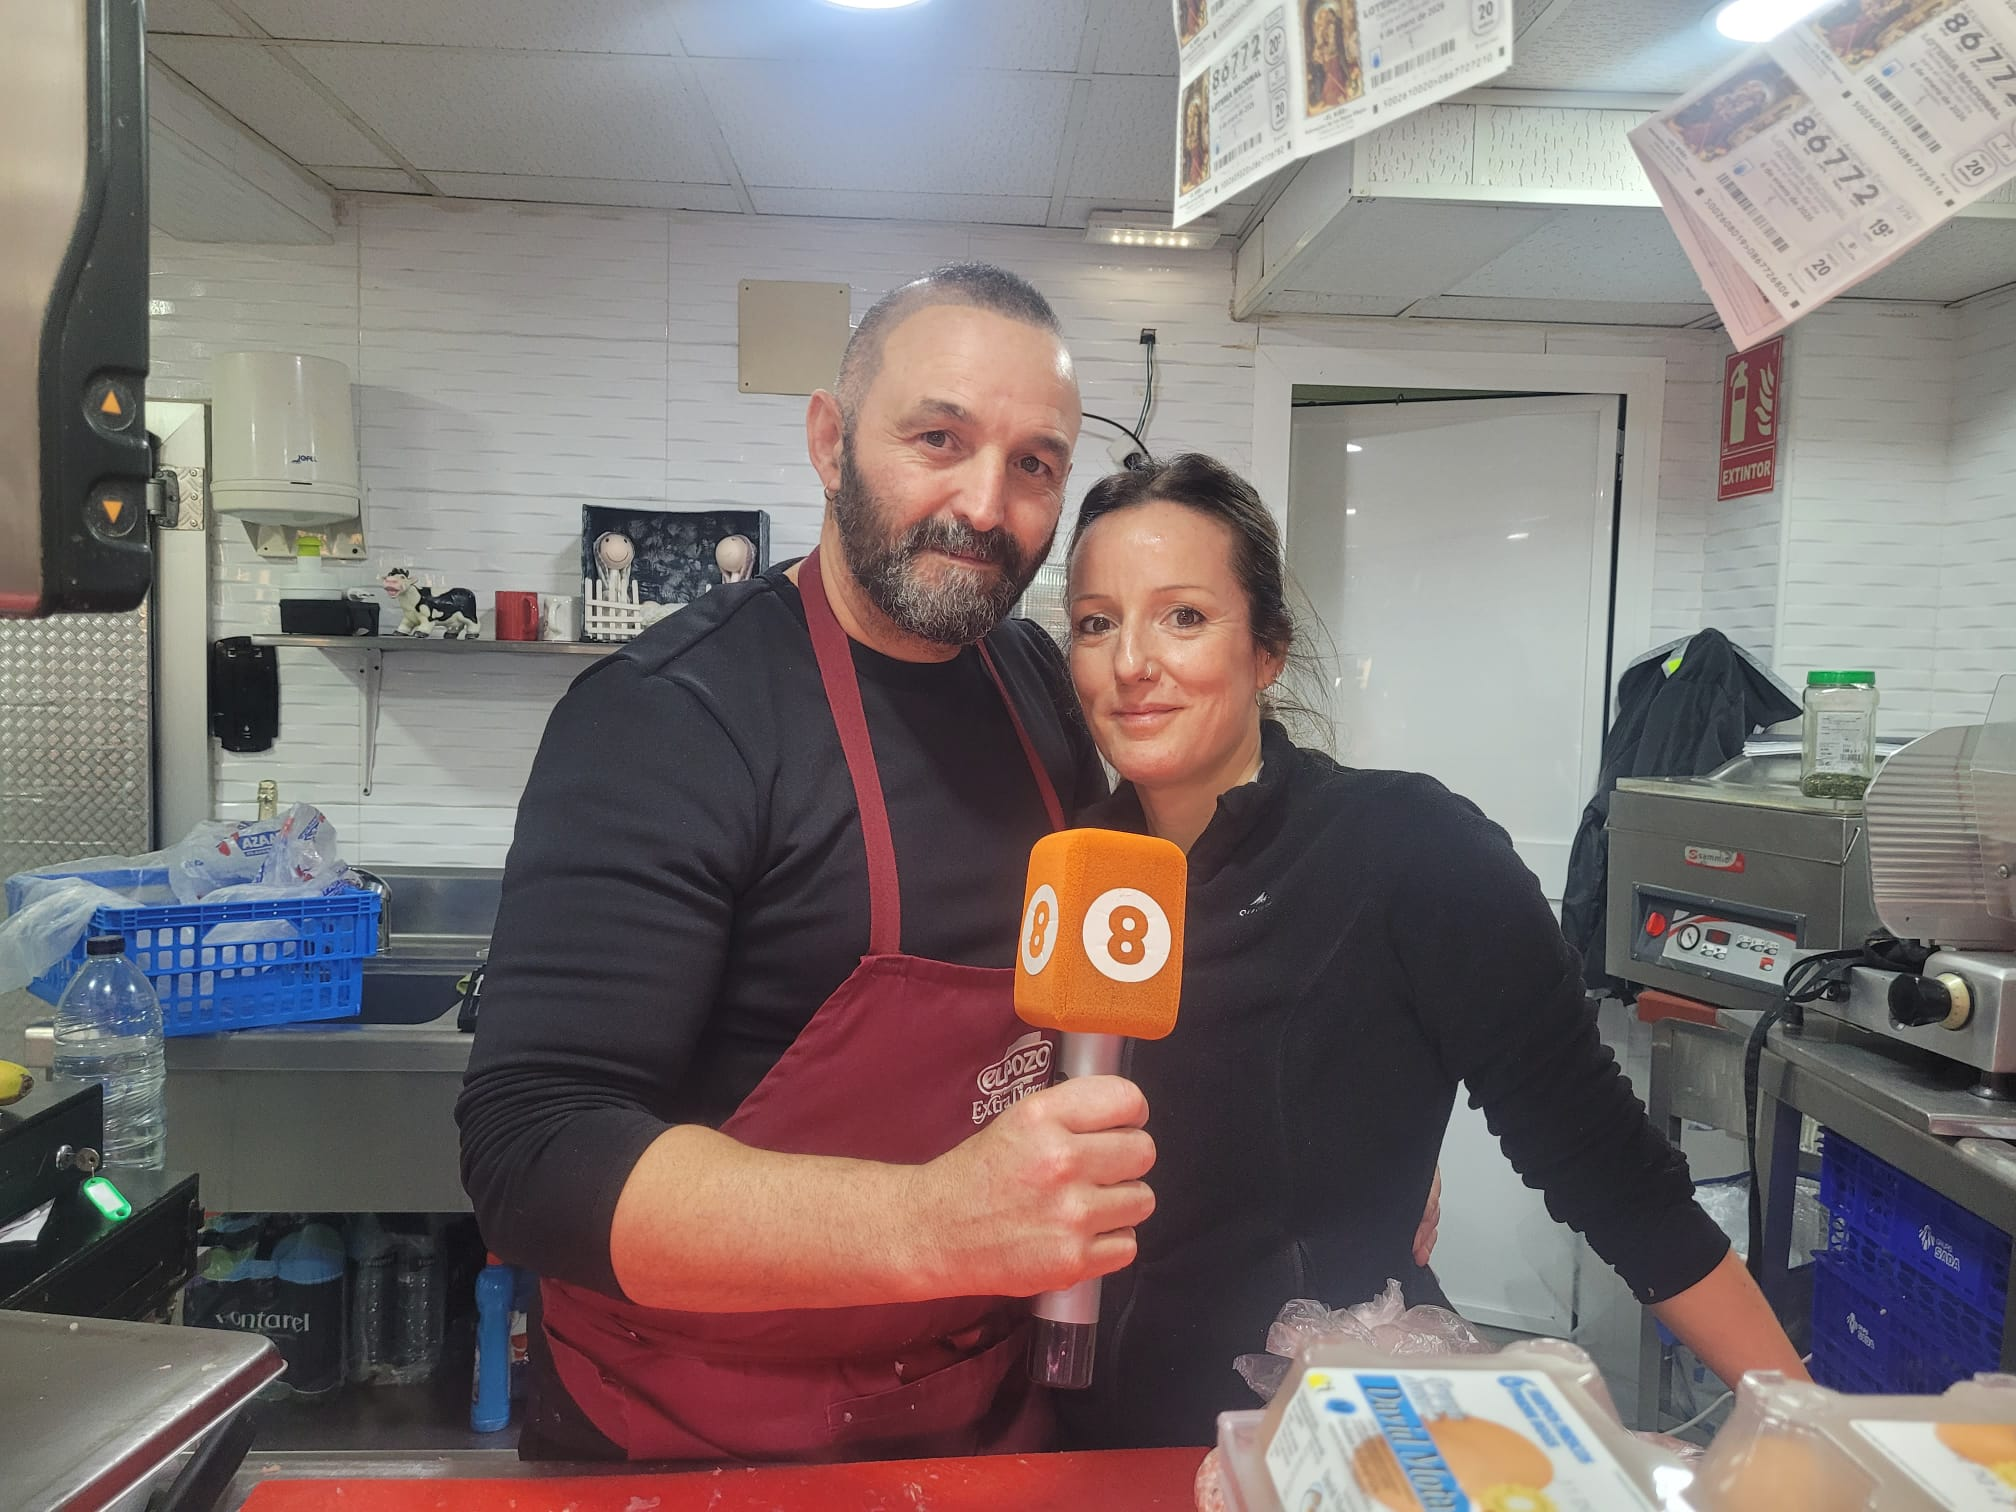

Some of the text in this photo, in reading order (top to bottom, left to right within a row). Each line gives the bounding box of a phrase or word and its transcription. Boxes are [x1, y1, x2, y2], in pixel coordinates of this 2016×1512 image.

[1478, 2, 1493, 20] 20
[1212, 33, 1261, 90] 86772
[1275, 101, 1284, 118] 20
[1789, 113, 1880, 207] 86772
[1965, 158, 1984, 178] 20
[1811, 256, 1831, 278] 20
[1722, 460, 1771, 486] EXTINTOR
[1025, 901, 1050, 958] 8
[1107, 905, 1149, 965] 8
[1934, 1246, 1960, 1272] SADA
